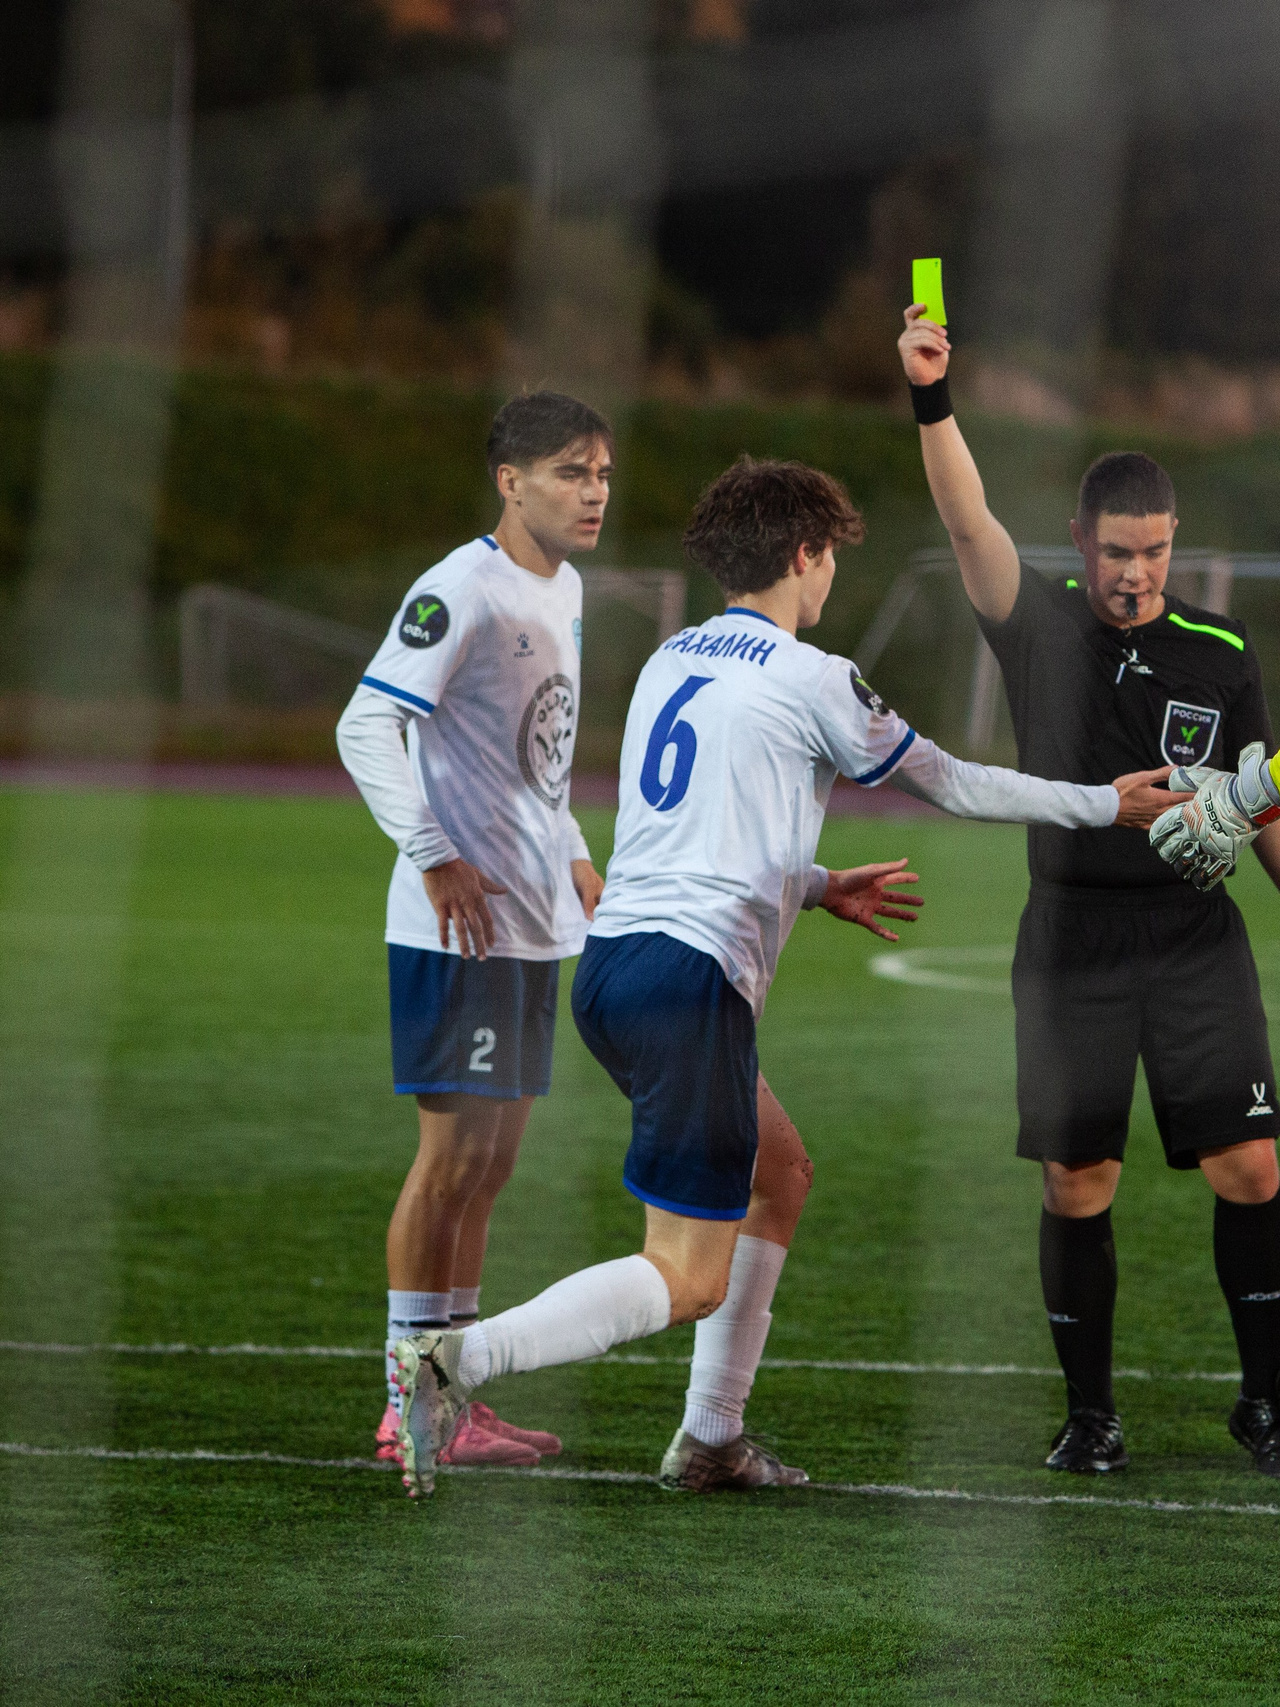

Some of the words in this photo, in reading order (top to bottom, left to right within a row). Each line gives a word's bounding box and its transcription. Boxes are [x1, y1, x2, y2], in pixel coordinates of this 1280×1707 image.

[1172, 707, 1213, 724] РОССИЯ
[639, 674, 716, 812] 6
[468, 1027, 497, 1072] 2
